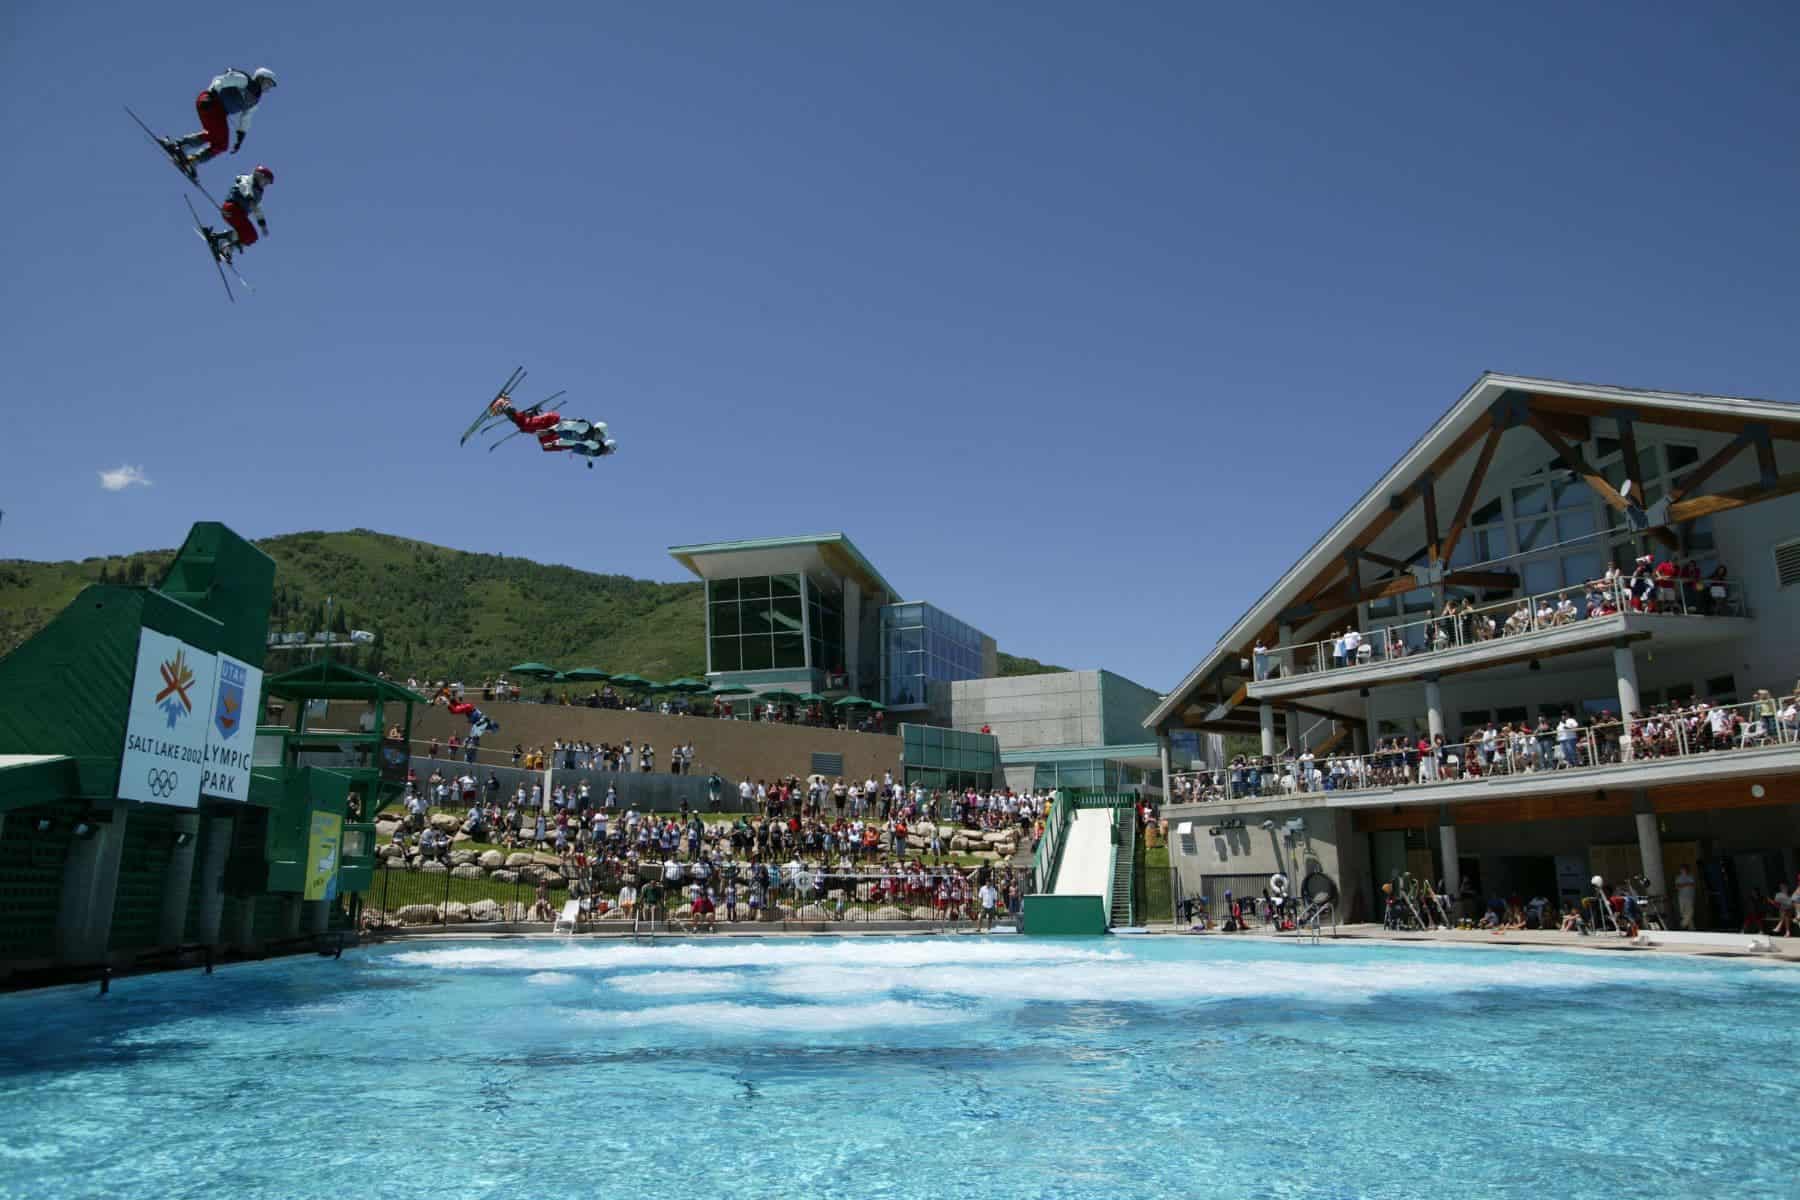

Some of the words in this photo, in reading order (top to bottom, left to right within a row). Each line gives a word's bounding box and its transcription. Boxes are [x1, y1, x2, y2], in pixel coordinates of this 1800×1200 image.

[127, 734, 153, 753] SALT
[155, 742, 181, 760] LAKE
[182, 746, 202, 765] 2002
[203, 744, 250, 771] LYMPIC
[203, 769, 236, 793] PARK
